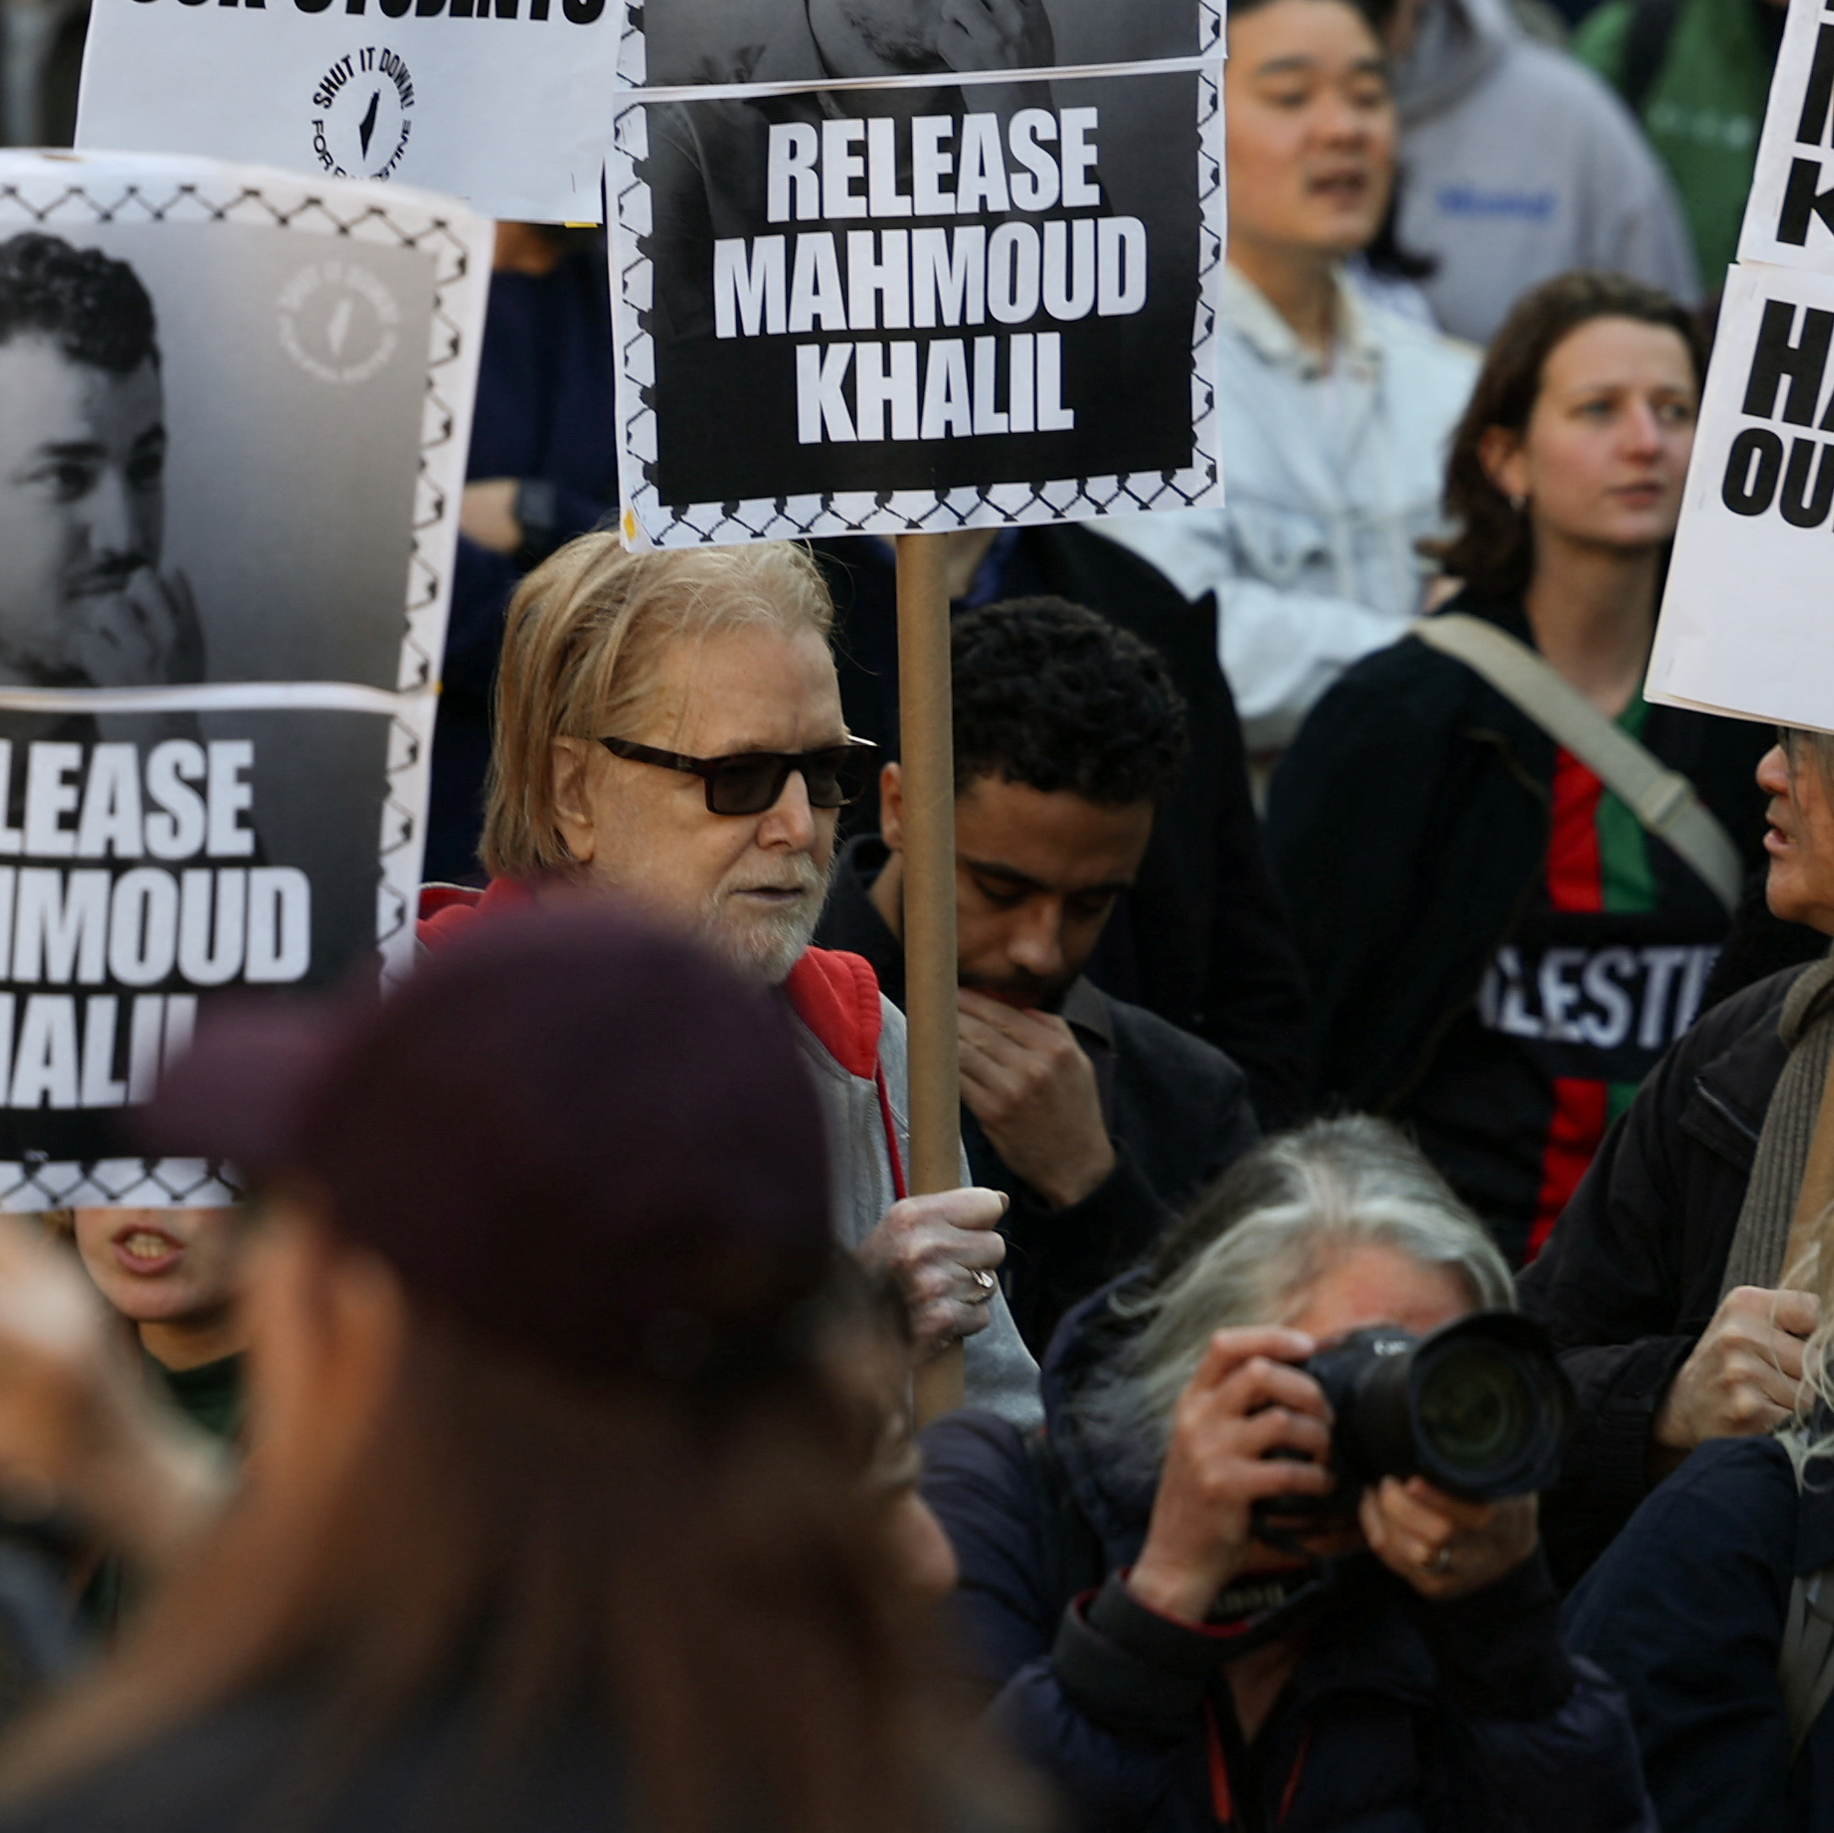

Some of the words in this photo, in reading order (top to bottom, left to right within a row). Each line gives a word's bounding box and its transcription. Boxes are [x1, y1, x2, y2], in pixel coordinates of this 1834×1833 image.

[313, 54, 355, 109] SHUT
[358, 46, 377, 73] IT
[311, 118, 335, 172] FOR
[767, 106, 1100, 223] RELEASE
[713, 216, 1148, 339] MAHMOUD
[796, 331, 1075, 444] KHALIL
